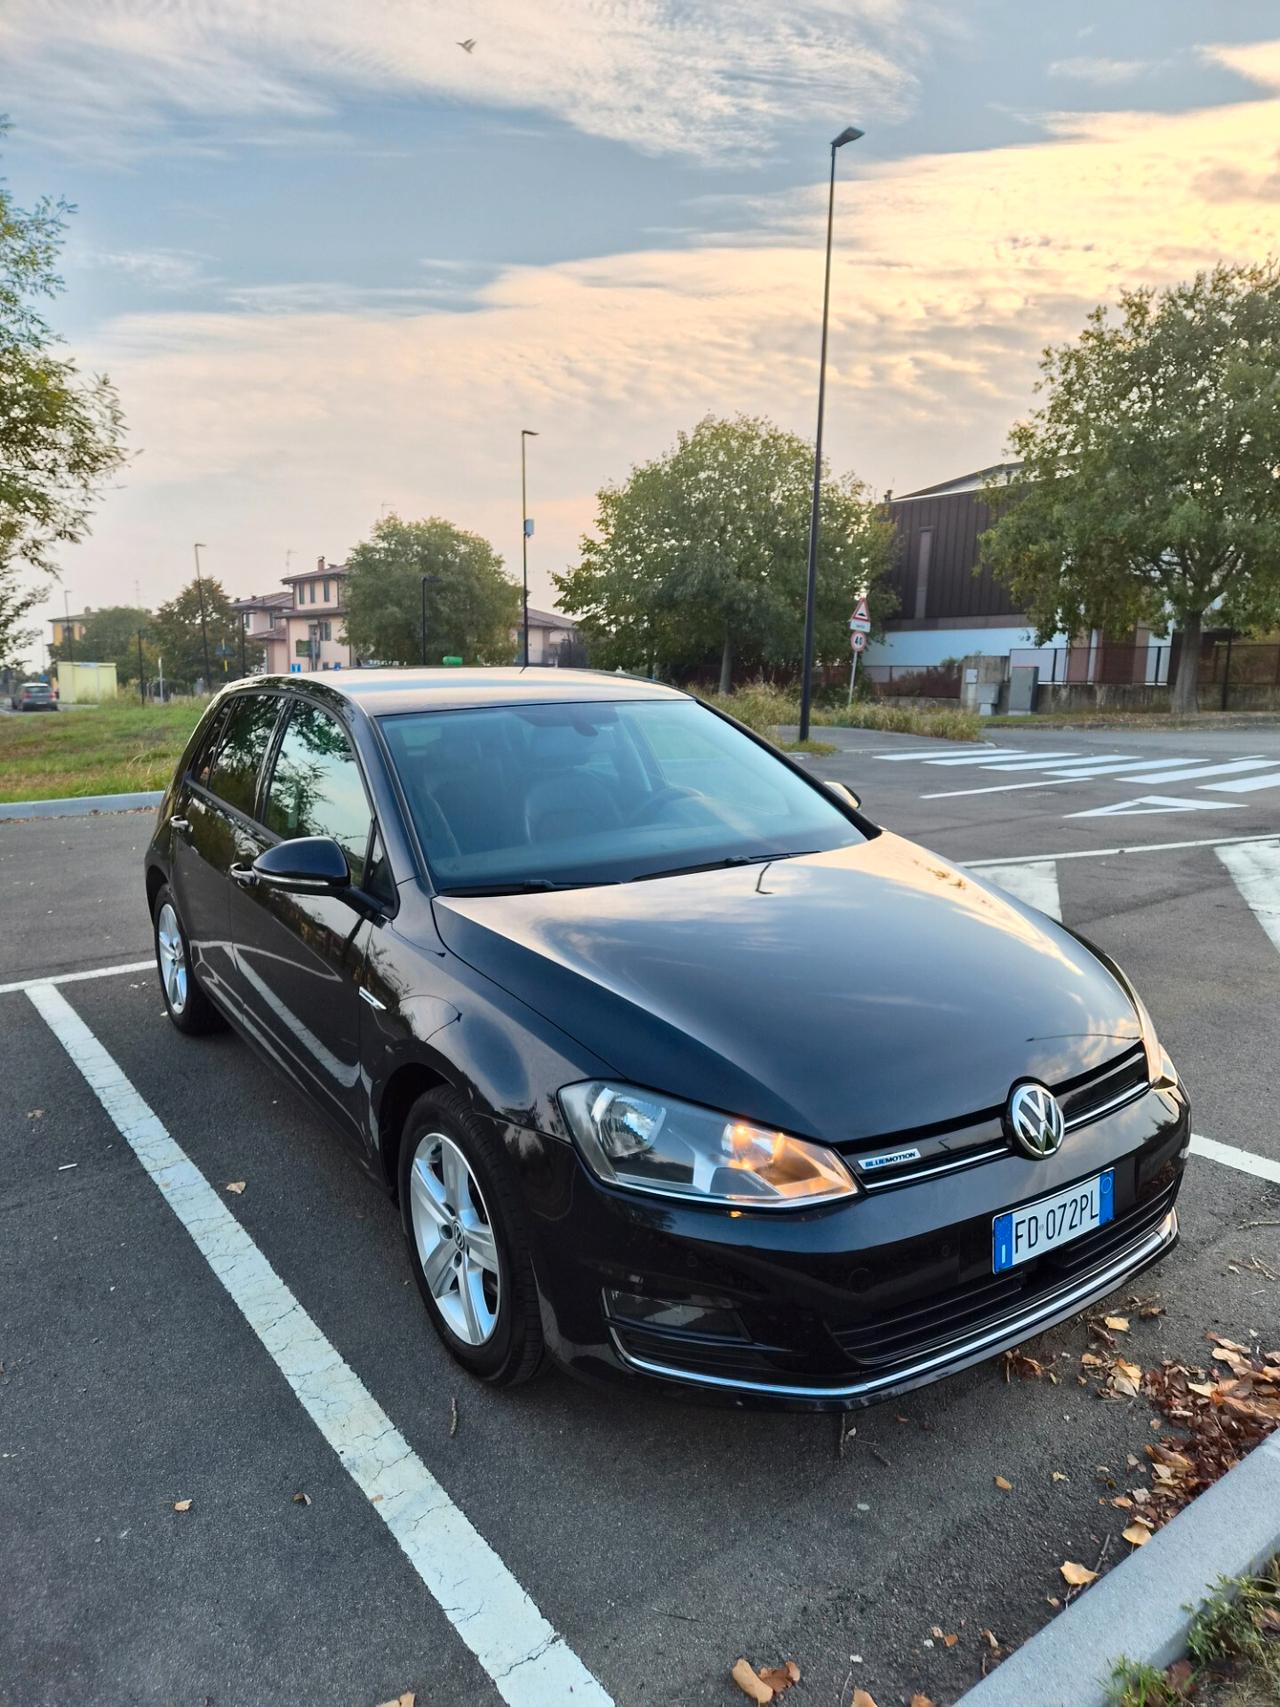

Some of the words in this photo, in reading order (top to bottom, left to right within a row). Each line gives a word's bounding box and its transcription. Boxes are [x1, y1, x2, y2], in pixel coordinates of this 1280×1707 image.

[865, 1151, 916, 1167] BLUEMOTION
[1015, 1215, 1039, 1254] FD
[1046, 1190, 1099, 1240] 072PL
